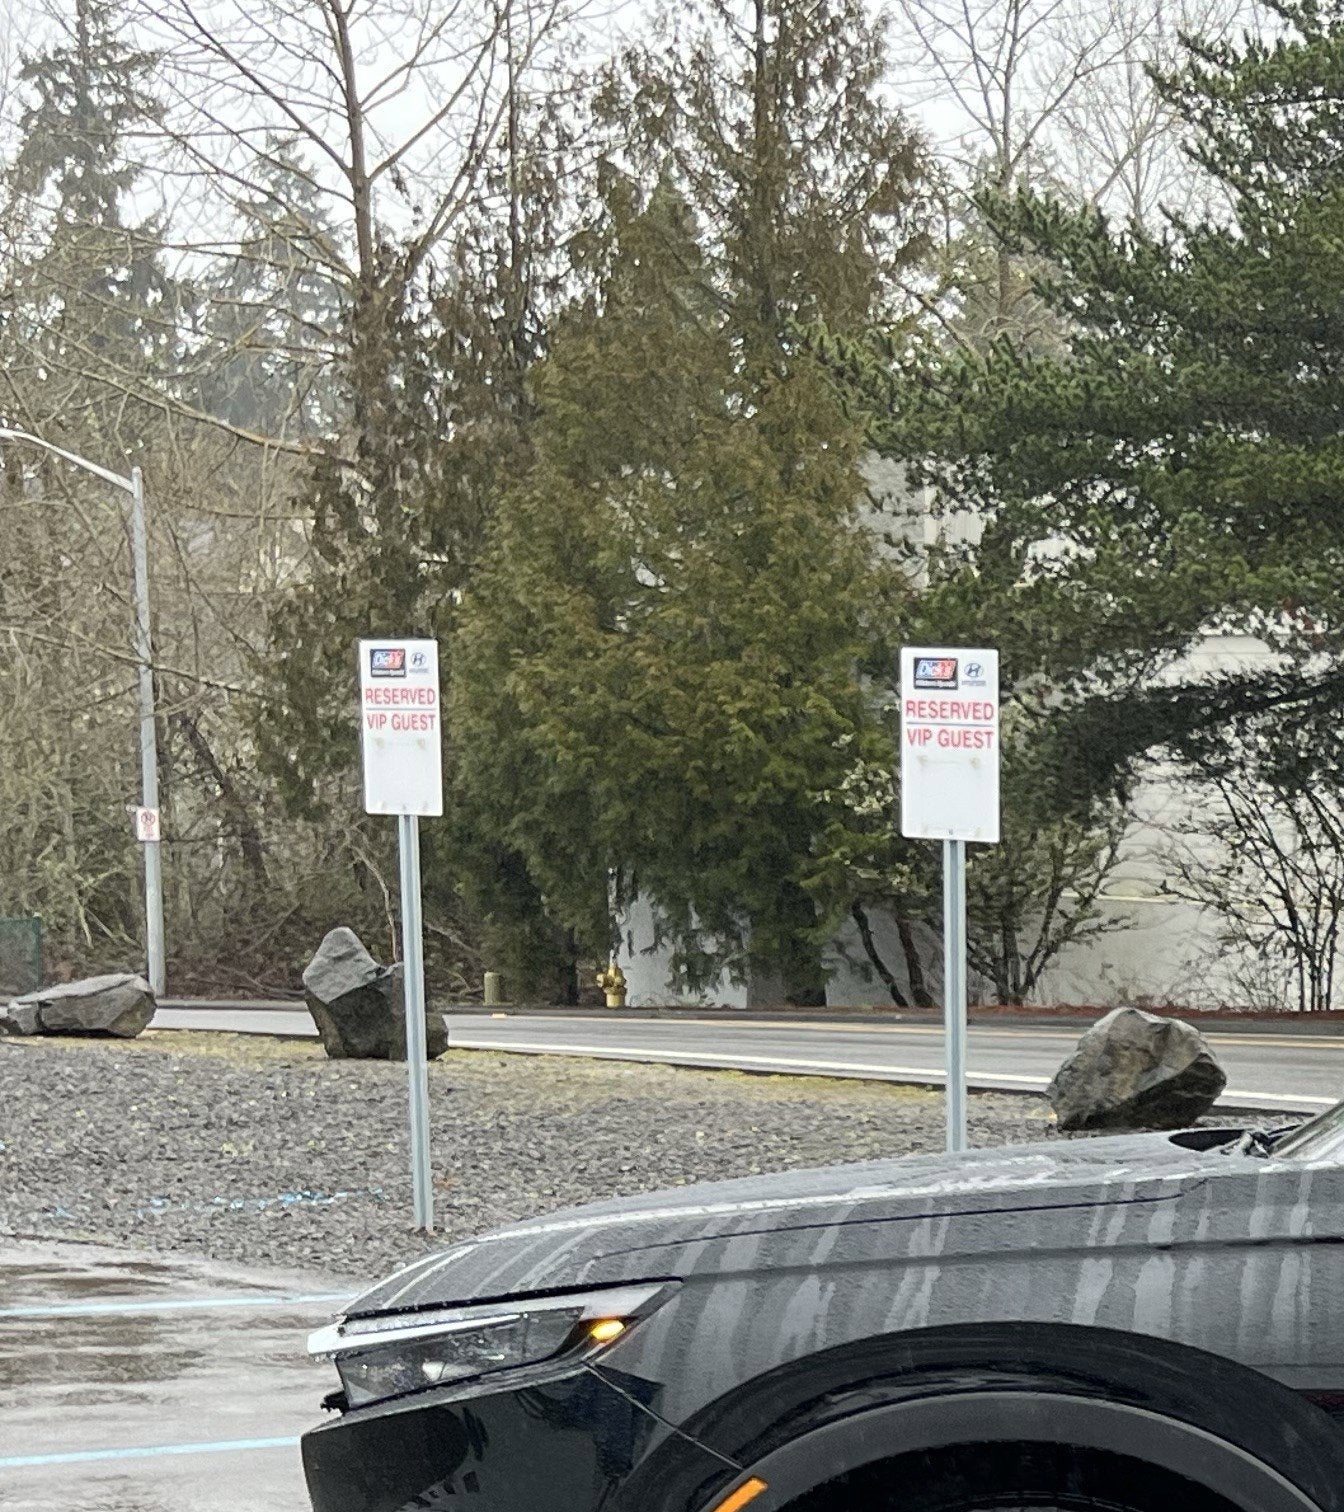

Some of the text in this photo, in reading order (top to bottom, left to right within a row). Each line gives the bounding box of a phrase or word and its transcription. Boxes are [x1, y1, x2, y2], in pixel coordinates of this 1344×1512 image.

[365, 687, 436, 705] RESERVED
[905, 700, 995, 720] RESERVED
[367, 714, 436, 731] VIP GUEST
[906, 728, 994, 749] VIP GUEST
